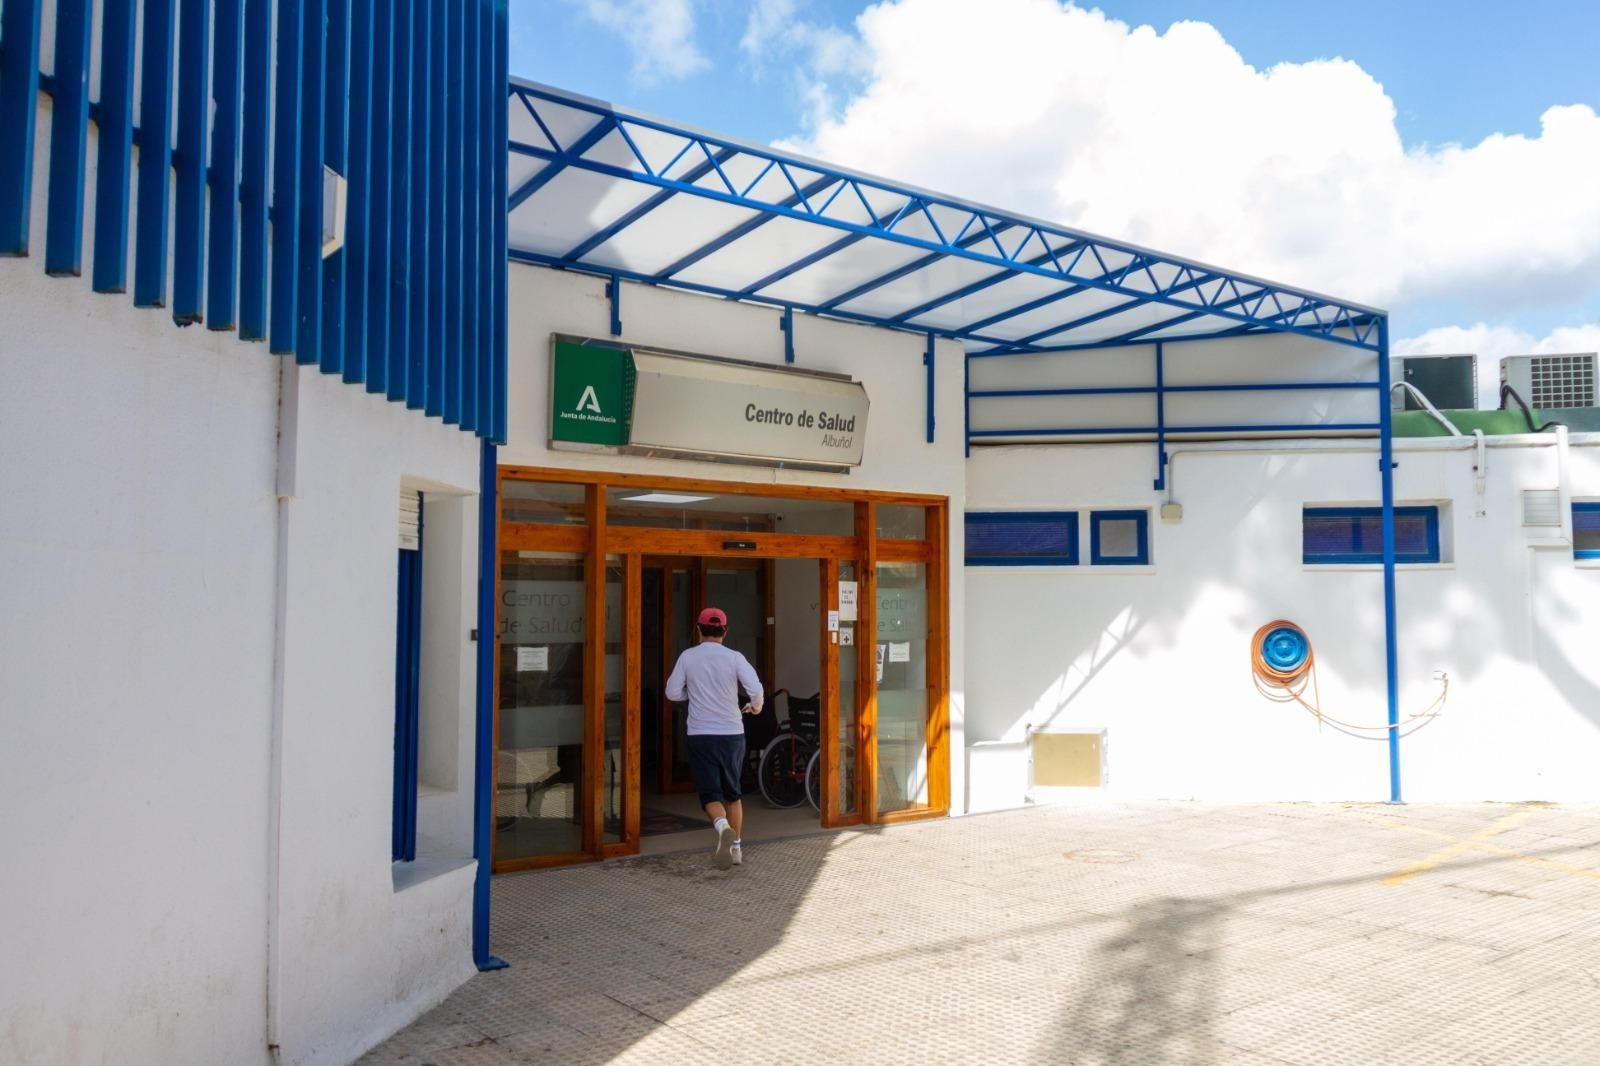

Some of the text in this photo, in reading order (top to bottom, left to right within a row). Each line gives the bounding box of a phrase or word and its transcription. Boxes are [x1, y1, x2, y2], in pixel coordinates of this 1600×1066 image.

[560, 411, 617, 423] Junta de Andalucía
[745, 403, 856, 433] Centro de Salud
[821, 433, 853, 449] Albuñol
[502, 589, 571, 607] Centro
[528, 616, 584, 633] Salud
